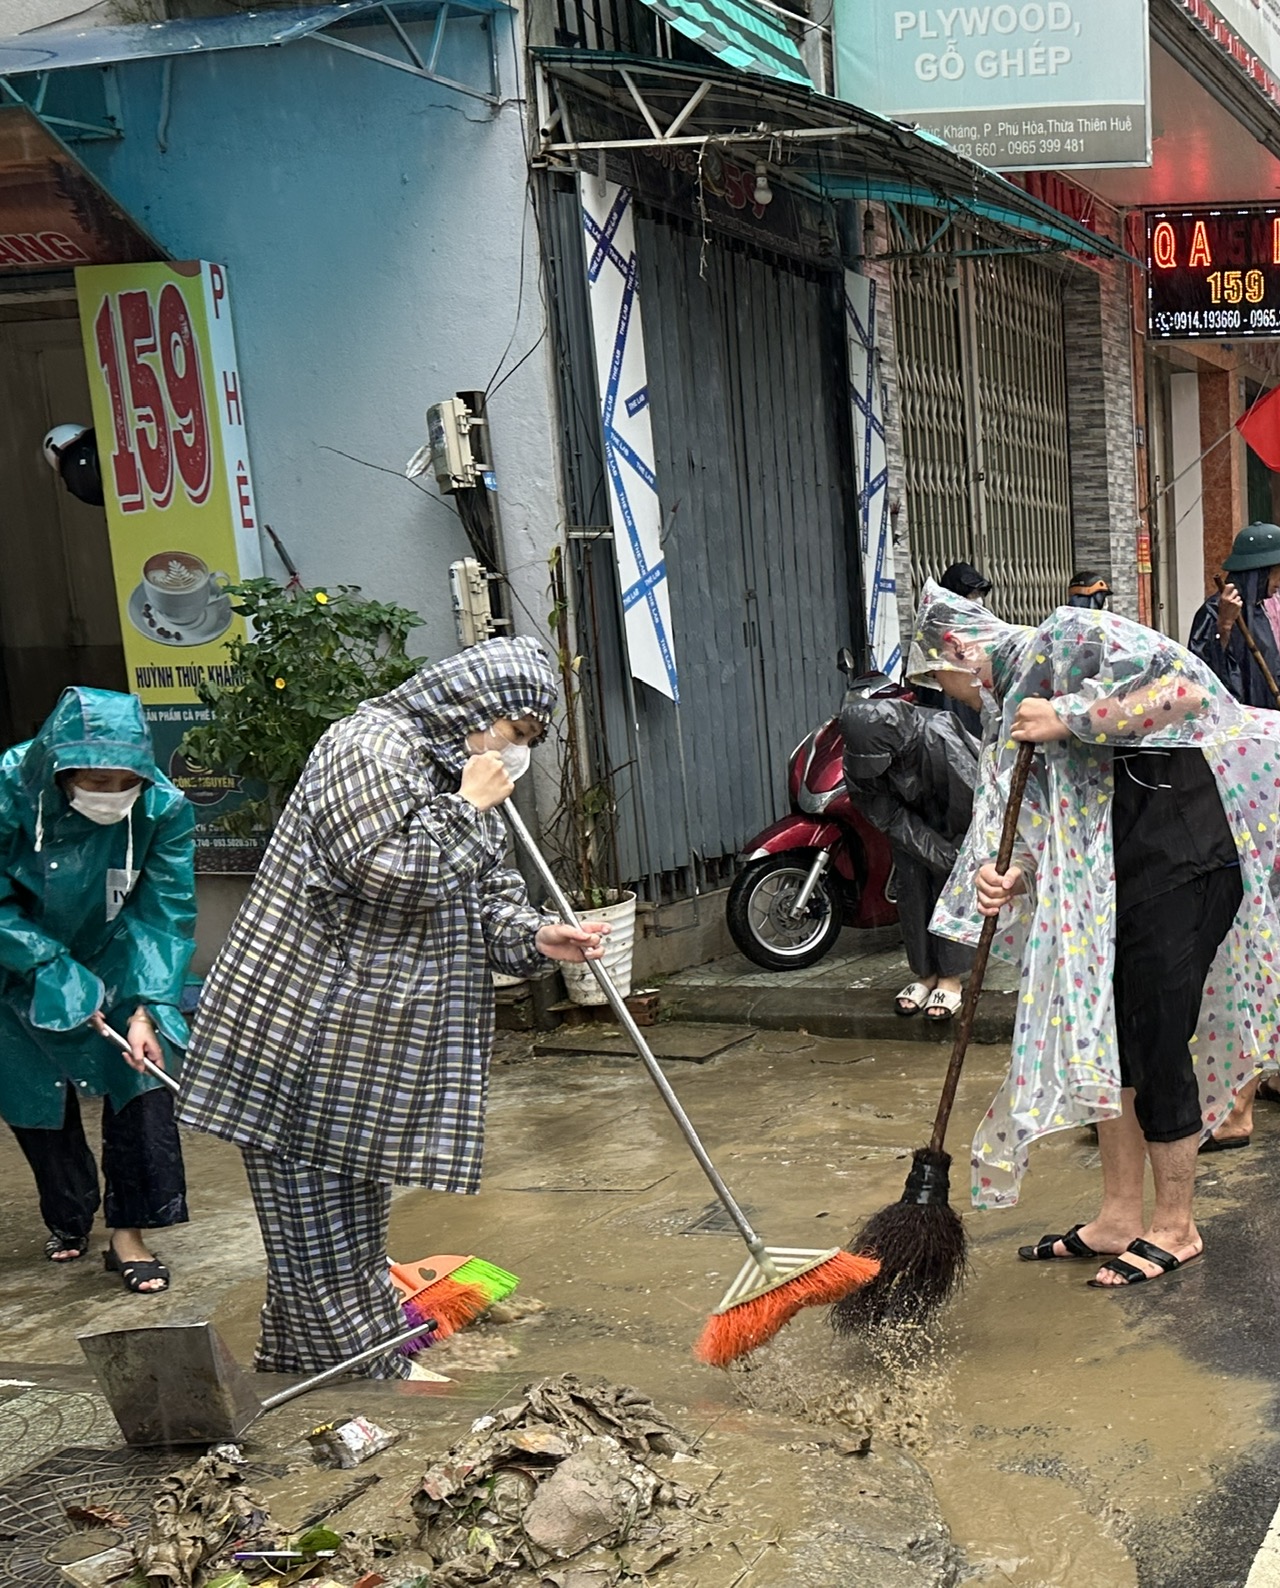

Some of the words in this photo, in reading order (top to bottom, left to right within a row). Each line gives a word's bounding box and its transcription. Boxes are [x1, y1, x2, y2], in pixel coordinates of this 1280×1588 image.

[894, 2, 1082, 40] PLYWOOD,
[915, 39, 966, 82] GỖ
[975, 38, 1073, 79] GHÉP
[943, 124, 981, 141] Kháng,
[1076, 118, 1108, 133] Thiên
[1110, 116, 1133, 133] Huế
[975, 142, 997, 157] 660
[1008, 140, 1036, 154] 0965
[1039, 139, 1062, 153] 399
[1065, 138, 1085, 153] 481
[1206, 269, 1265, 304] 159
[1173, 309, 1241, 330] 0914.193660
[94, 283, 214, 513] 159
[135, 662, 174, 688] HUỲNH
